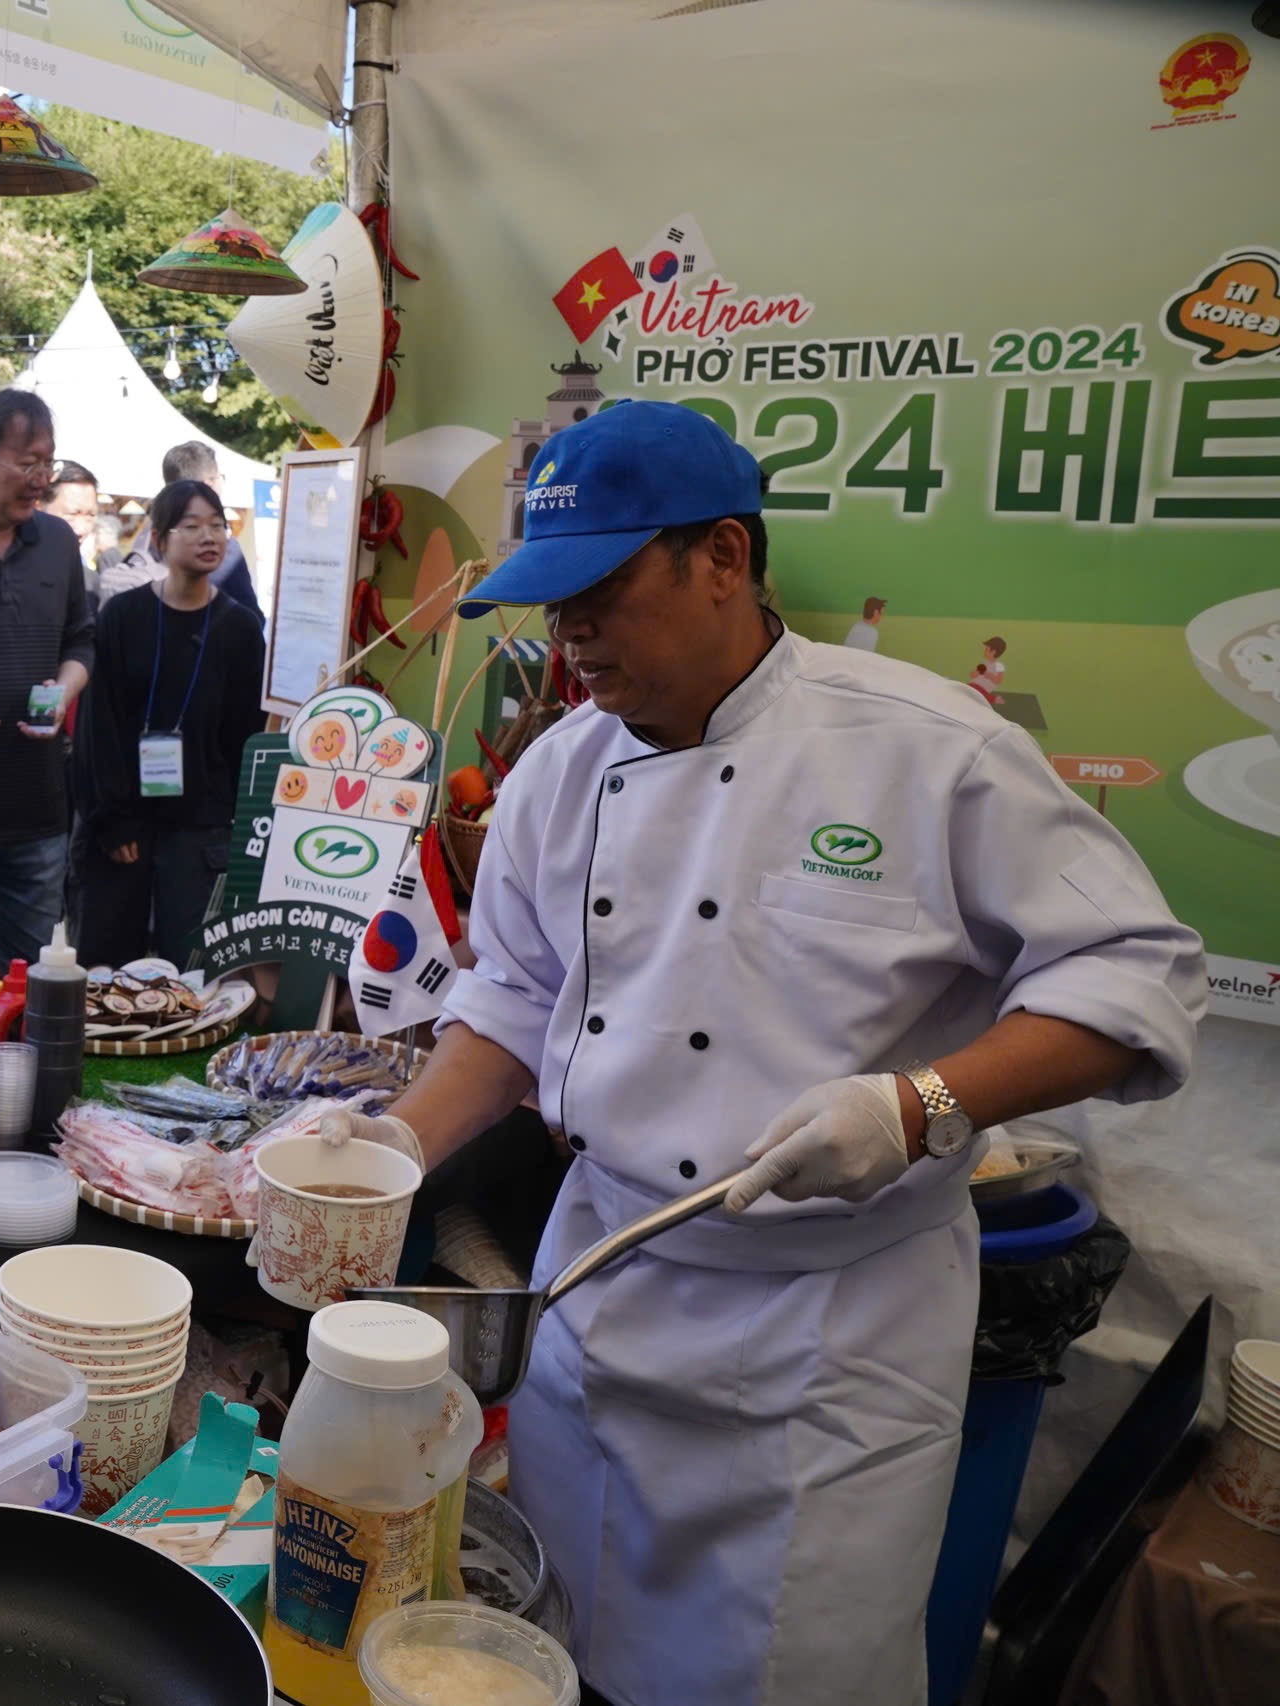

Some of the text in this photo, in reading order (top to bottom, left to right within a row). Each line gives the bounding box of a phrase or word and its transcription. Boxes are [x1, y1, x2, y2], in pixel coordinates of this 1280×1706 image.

[640, 279, 809, 338] Vietnam
[636, 328, 1141, 383] PHỞ FESTIVAL 2024
[526, 498, 577, 512] TRAVEL
[1078, 762, 1124, 779] PHO
[801, 859, 884, 882] VIETNAM GOLF
[284, 875, 370, 904] VIETNAM GOLF
[232, 907, 283, 933] NGON
[288, 905, 330, 929] CÒN
[212, 933, 350, 967] 맛있게 드시고 선물도
[286, 1500, 356, 1548] HEINZ
[276, 1531, 362, 1584] MAYONNAISE
[297, 1534, 340, 1561] MAGNIFICENT
[213, 1572, 235, 1589] 100
[292, 1569, 332, 1593] DELICIOUS
[302, 1584, 321, 1597] AND
